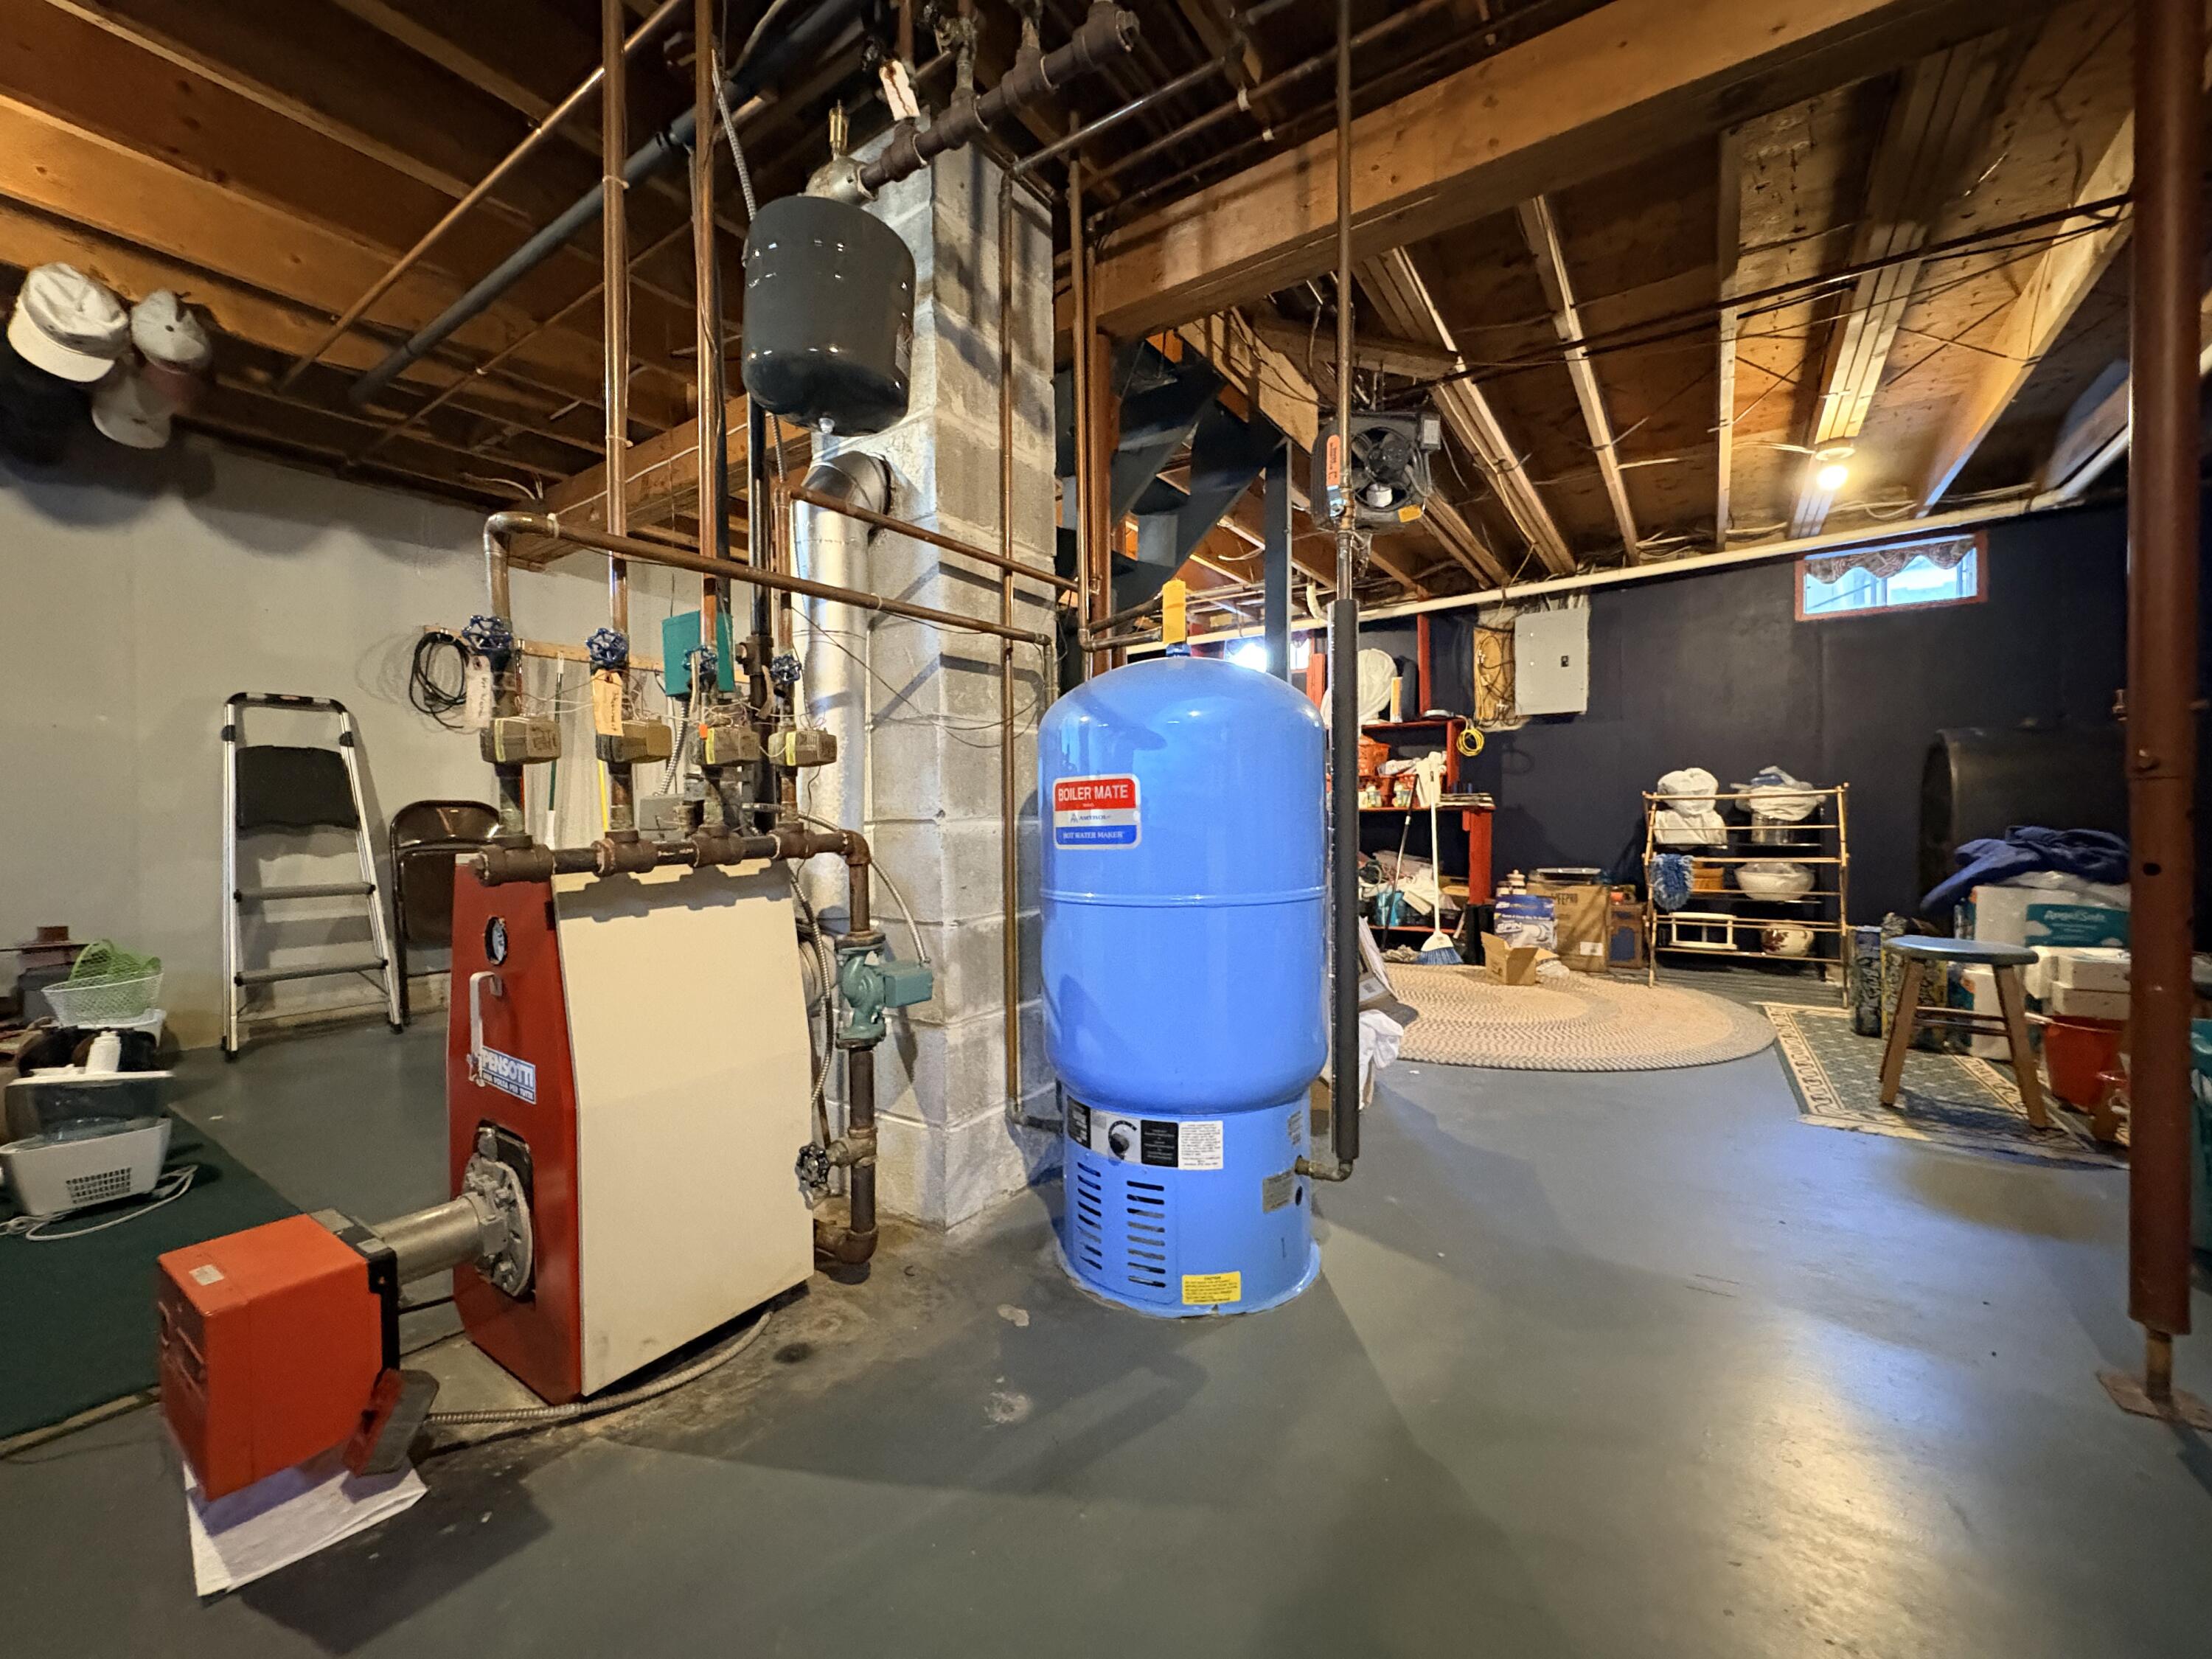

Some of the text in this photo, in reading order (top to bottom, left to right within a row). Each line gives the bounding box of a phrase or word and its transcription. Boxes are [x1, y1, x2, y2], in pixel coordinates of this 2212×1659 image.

[1058, 785, 1128, 801] BOILER MATE
[1097, 831, 1123, 839] MAKER
[483, 1049, 535, 1088] PENSOTTI
